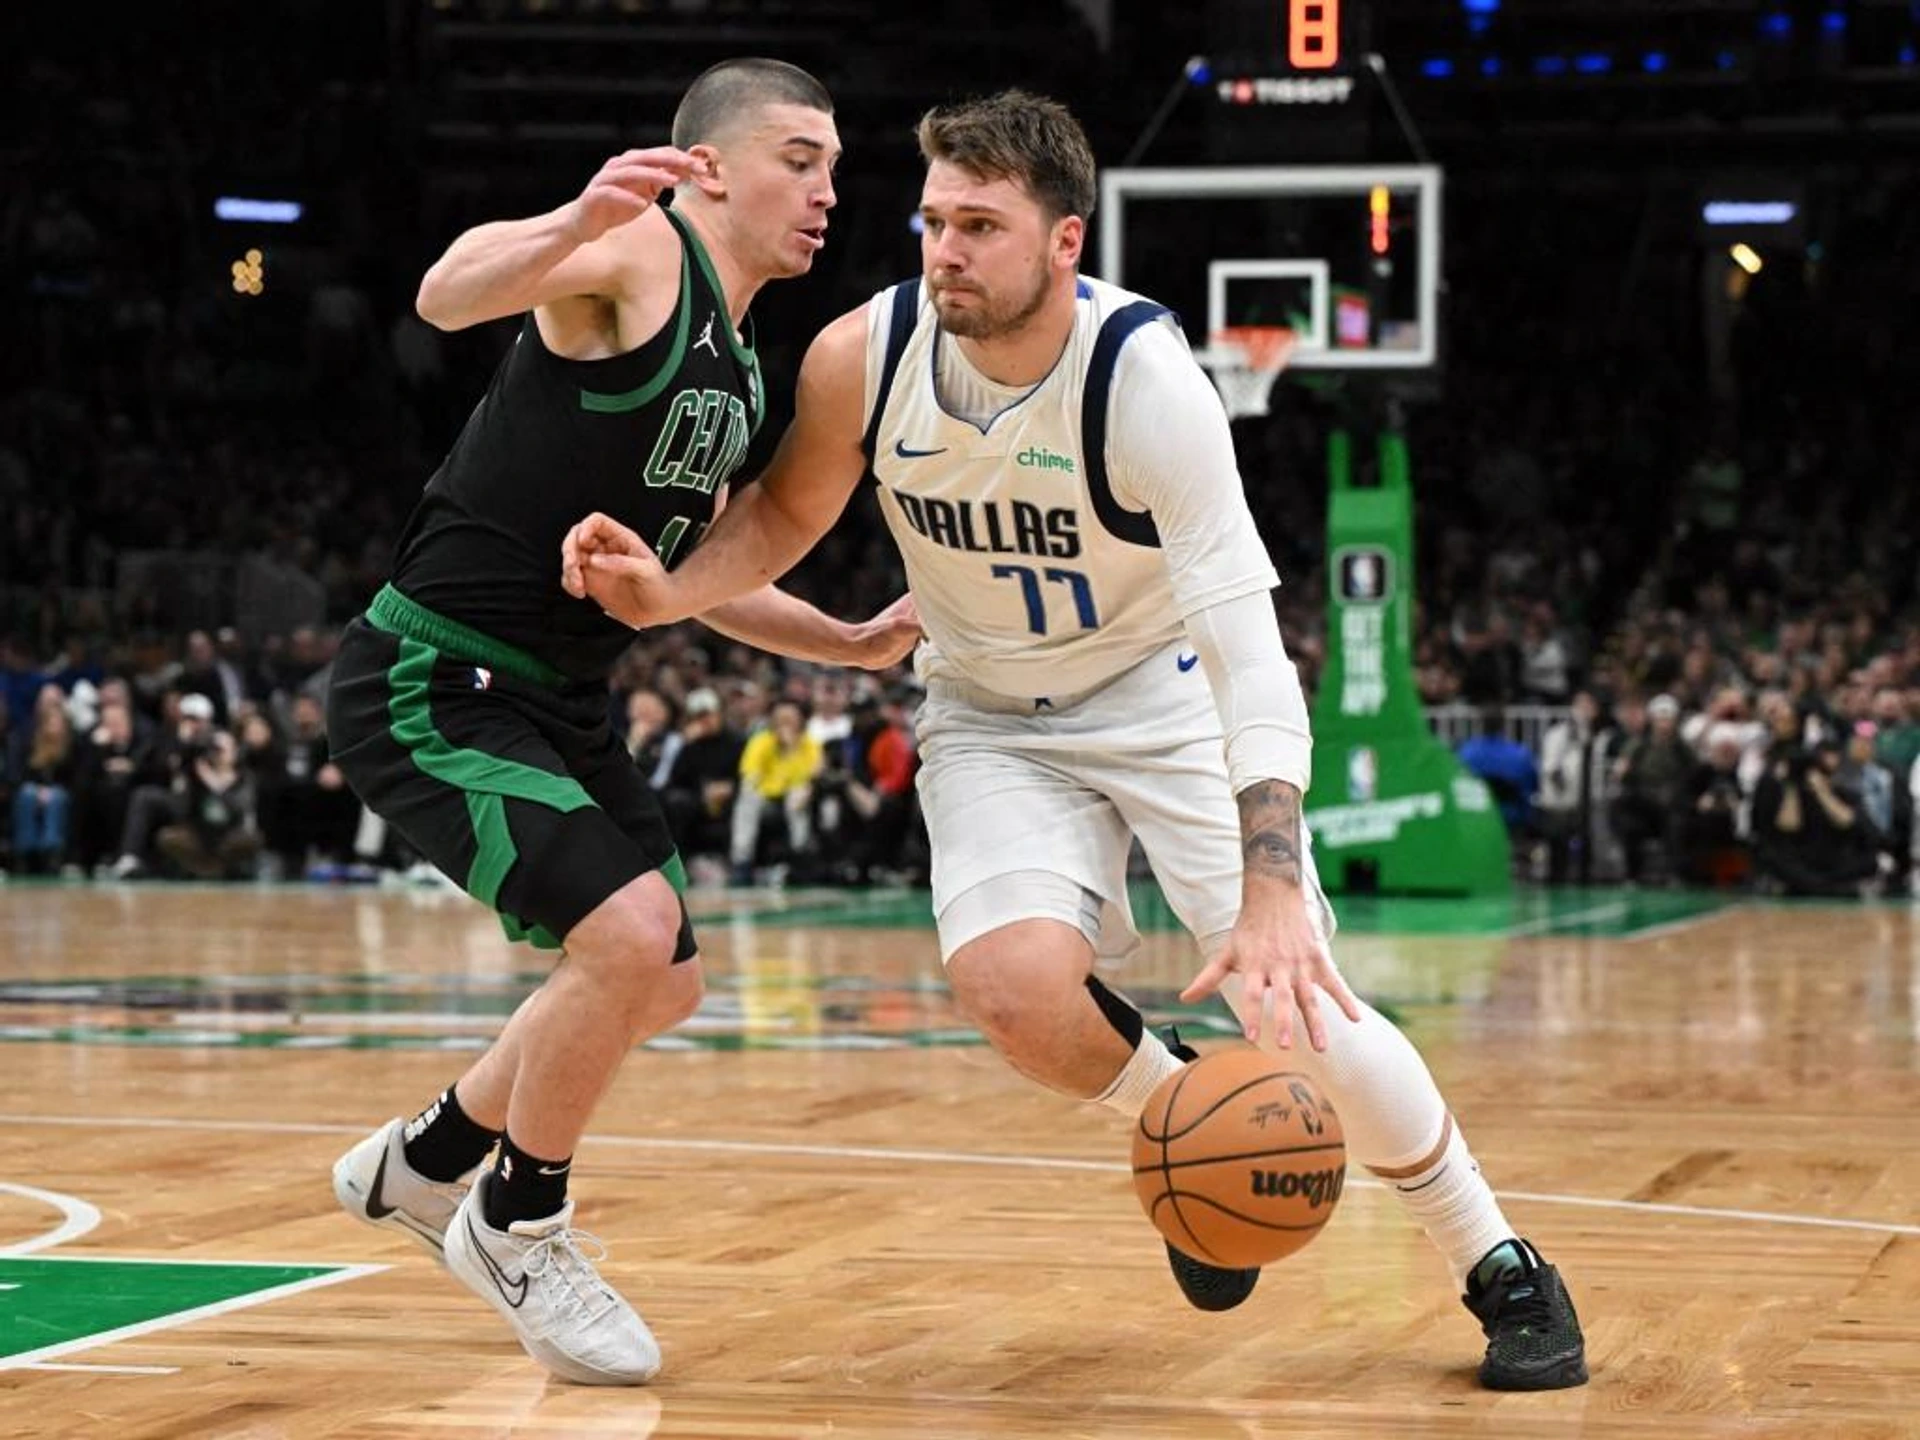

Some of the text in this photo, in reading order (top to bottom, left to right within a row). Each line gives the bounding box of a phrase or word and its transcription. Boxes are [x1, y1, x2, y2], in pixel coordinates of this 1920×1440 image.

[1289, 0, 1339, 68] 8
[1016, 446, 1075, 474] chime
[892, 488, 1081, 560] DALLAS
[990, 563, 1099, 636] 77
